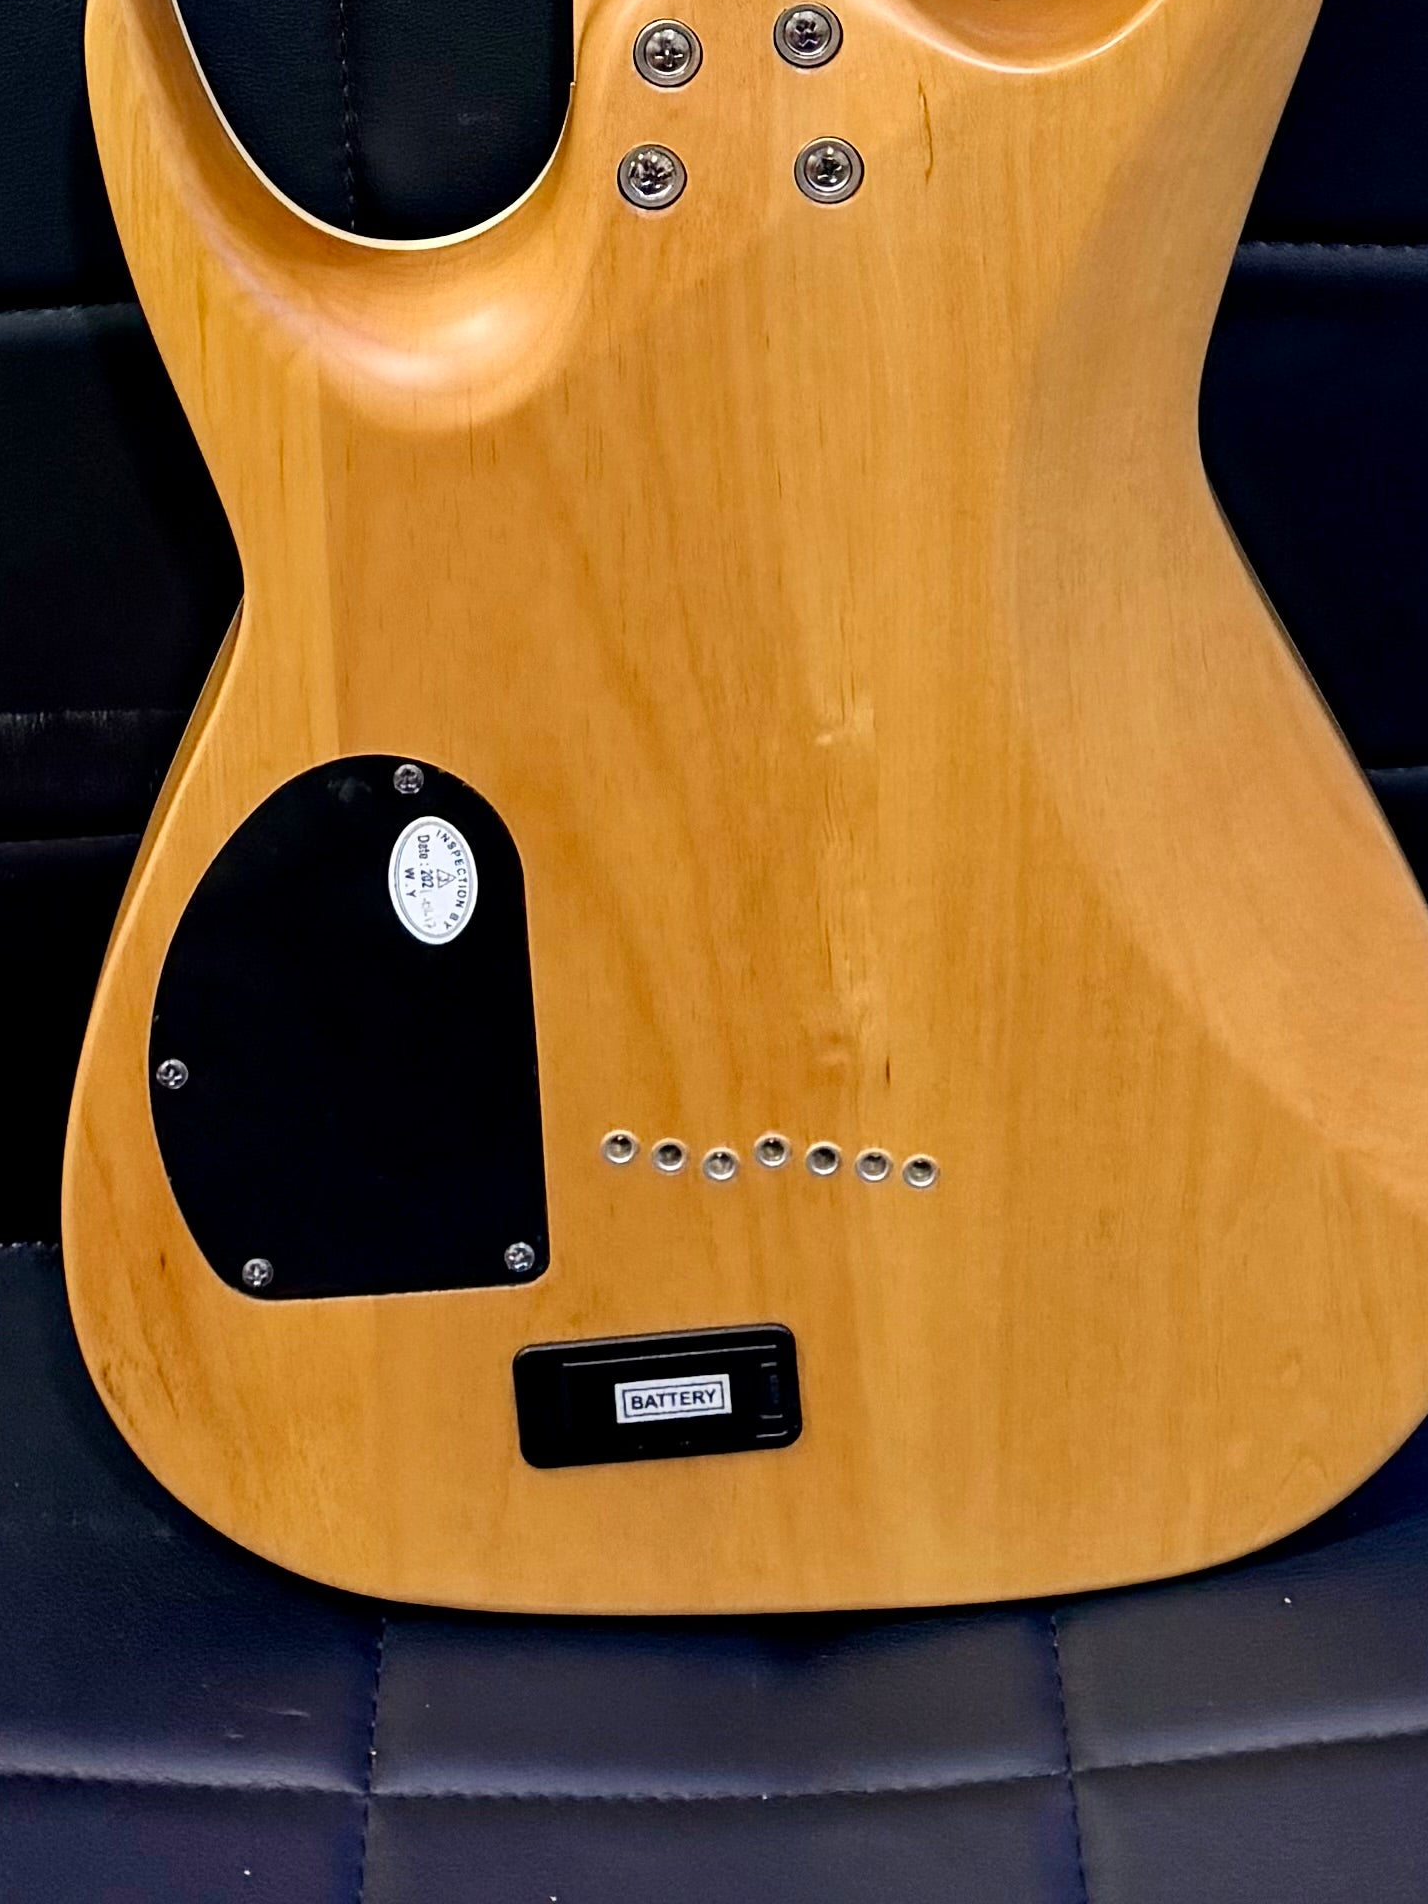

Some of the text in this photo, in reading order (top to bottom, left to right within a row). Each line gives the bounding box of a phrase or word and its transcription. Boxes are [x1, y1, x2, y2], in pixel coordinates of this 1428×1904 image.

[436, 828, 467, 930] INSPECTION BY
[631, 1389, 717, 1411] BATTERY
